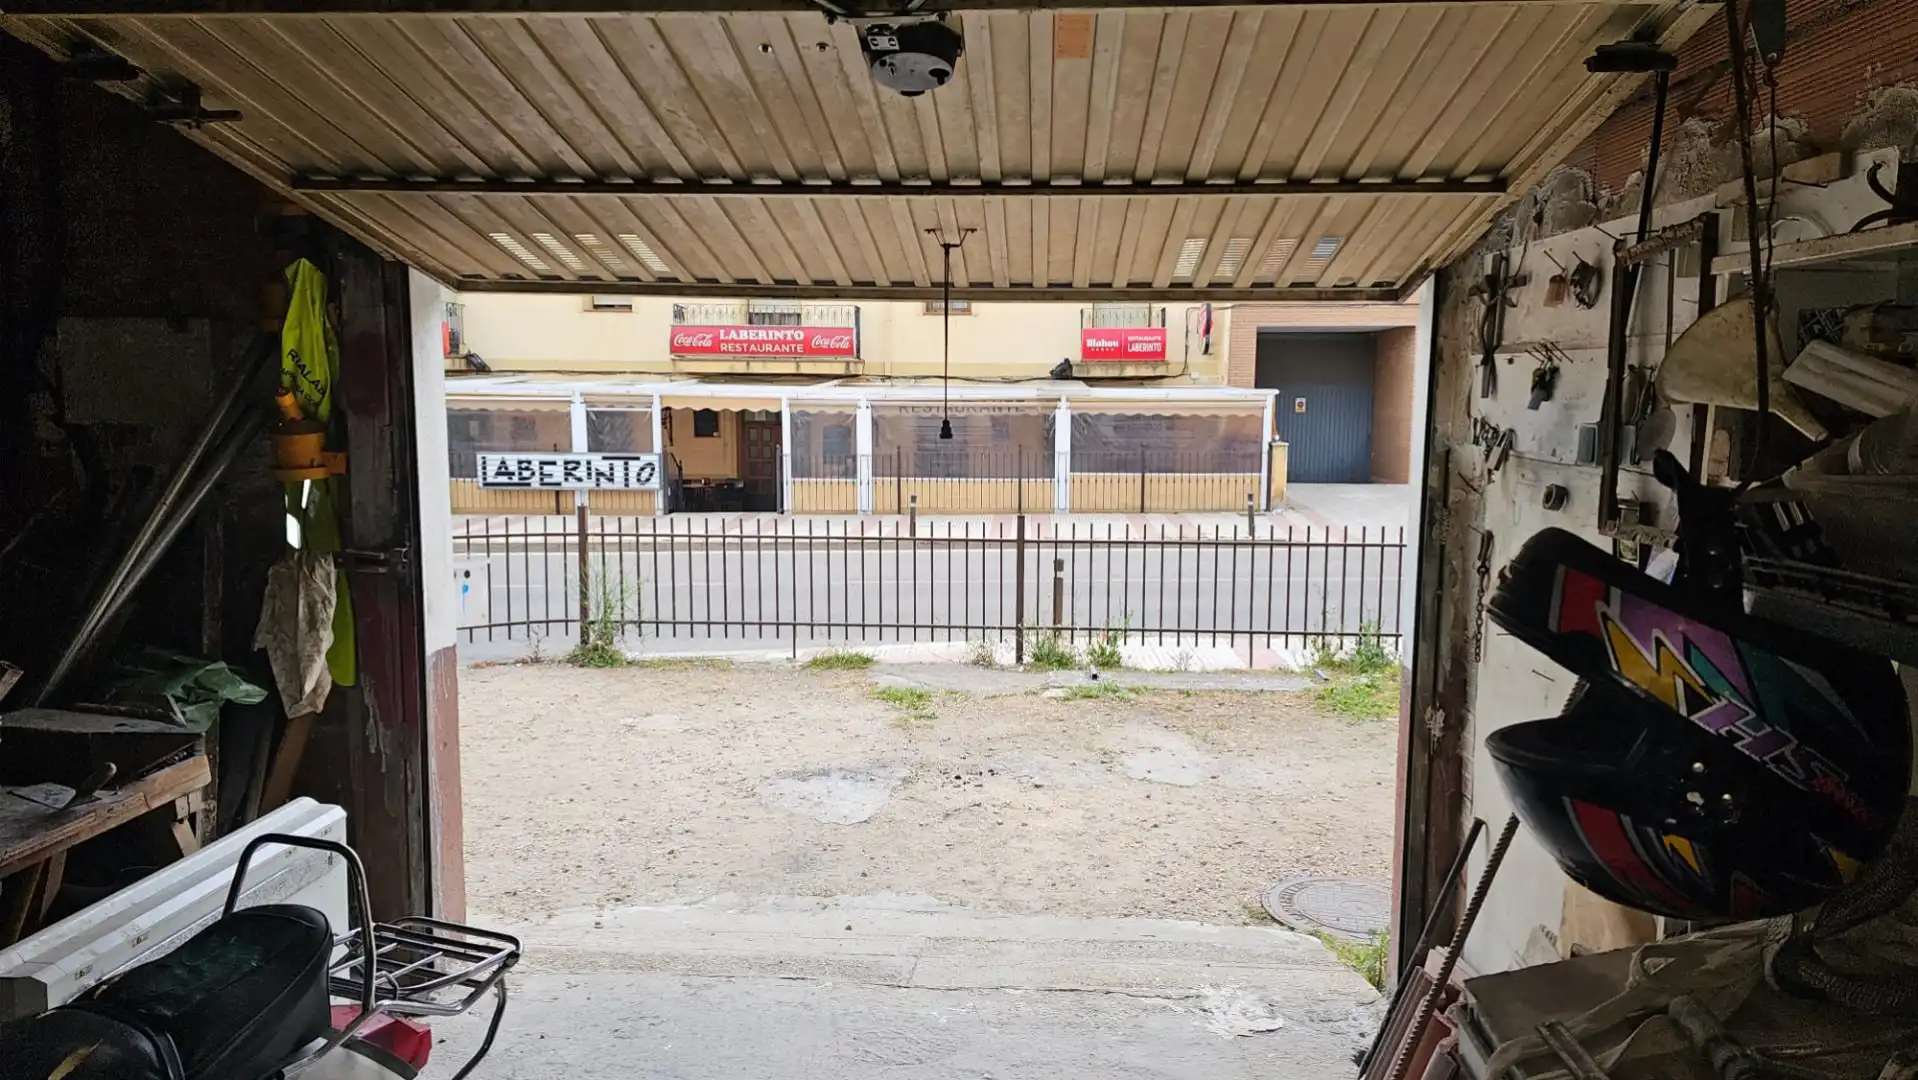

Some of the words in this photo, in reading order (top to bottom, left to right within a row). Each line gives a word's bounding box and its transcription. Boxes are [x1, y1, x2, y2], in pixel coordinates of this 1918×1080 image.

[719, 329, 804, 341] LABERINTO
[720, 343, 804, 353] RESTAURANTE
[1127, 342, 1162, 353] LABERINTO
[481, 456, 656, 488] LABERINTO
